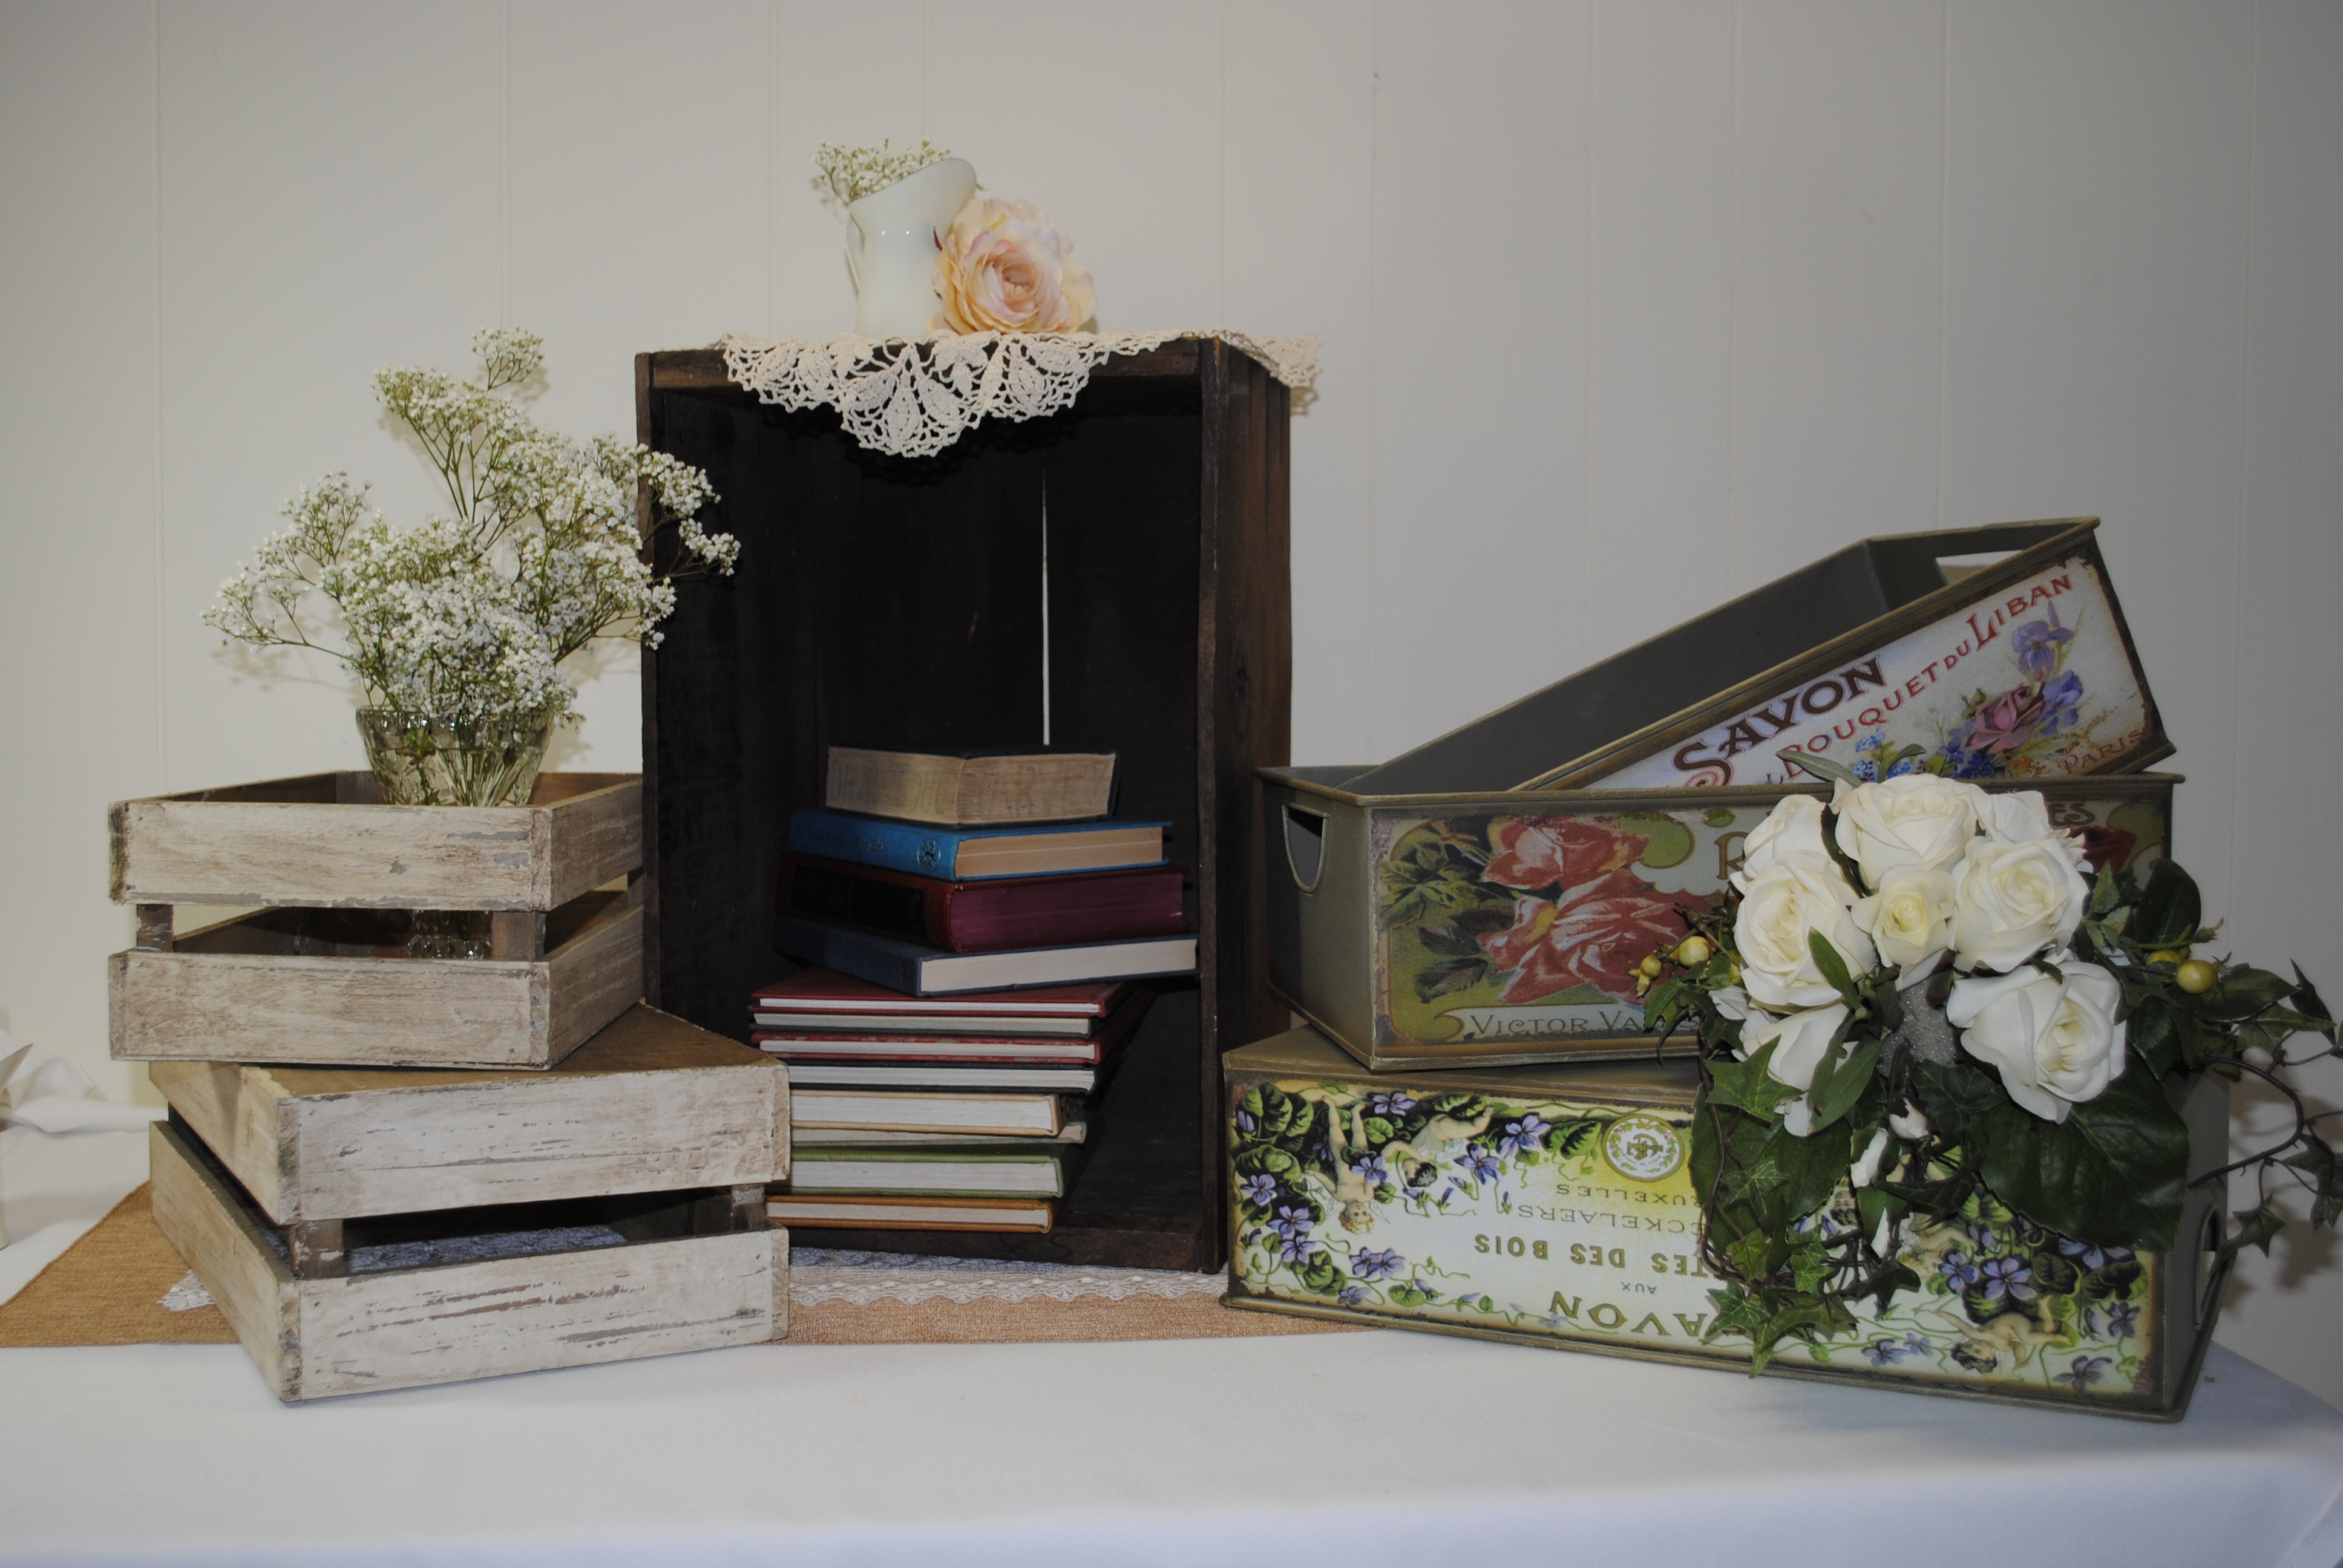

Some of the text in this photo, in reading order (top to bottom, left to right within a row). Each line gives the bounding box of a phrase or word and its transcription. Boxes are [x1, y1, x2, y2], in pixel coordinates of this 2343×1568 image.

[1942, 639, 1971, 670] DU
[1965, 575, 2074, 652] LIBAN
[1672, 655, 1887, 786] SAVON
[2057, 730, 2143, 774] PARIS
[2048, 802, 2096, 826] ES
[1518, 1204, 1706, 1235] ECKELAERS
[1473, 1233, 1709, 1278] TES DES BOIS
[1620, 1281, 1657, 1295] AUX
[1547, 1290, 1748, 1338] AVON
